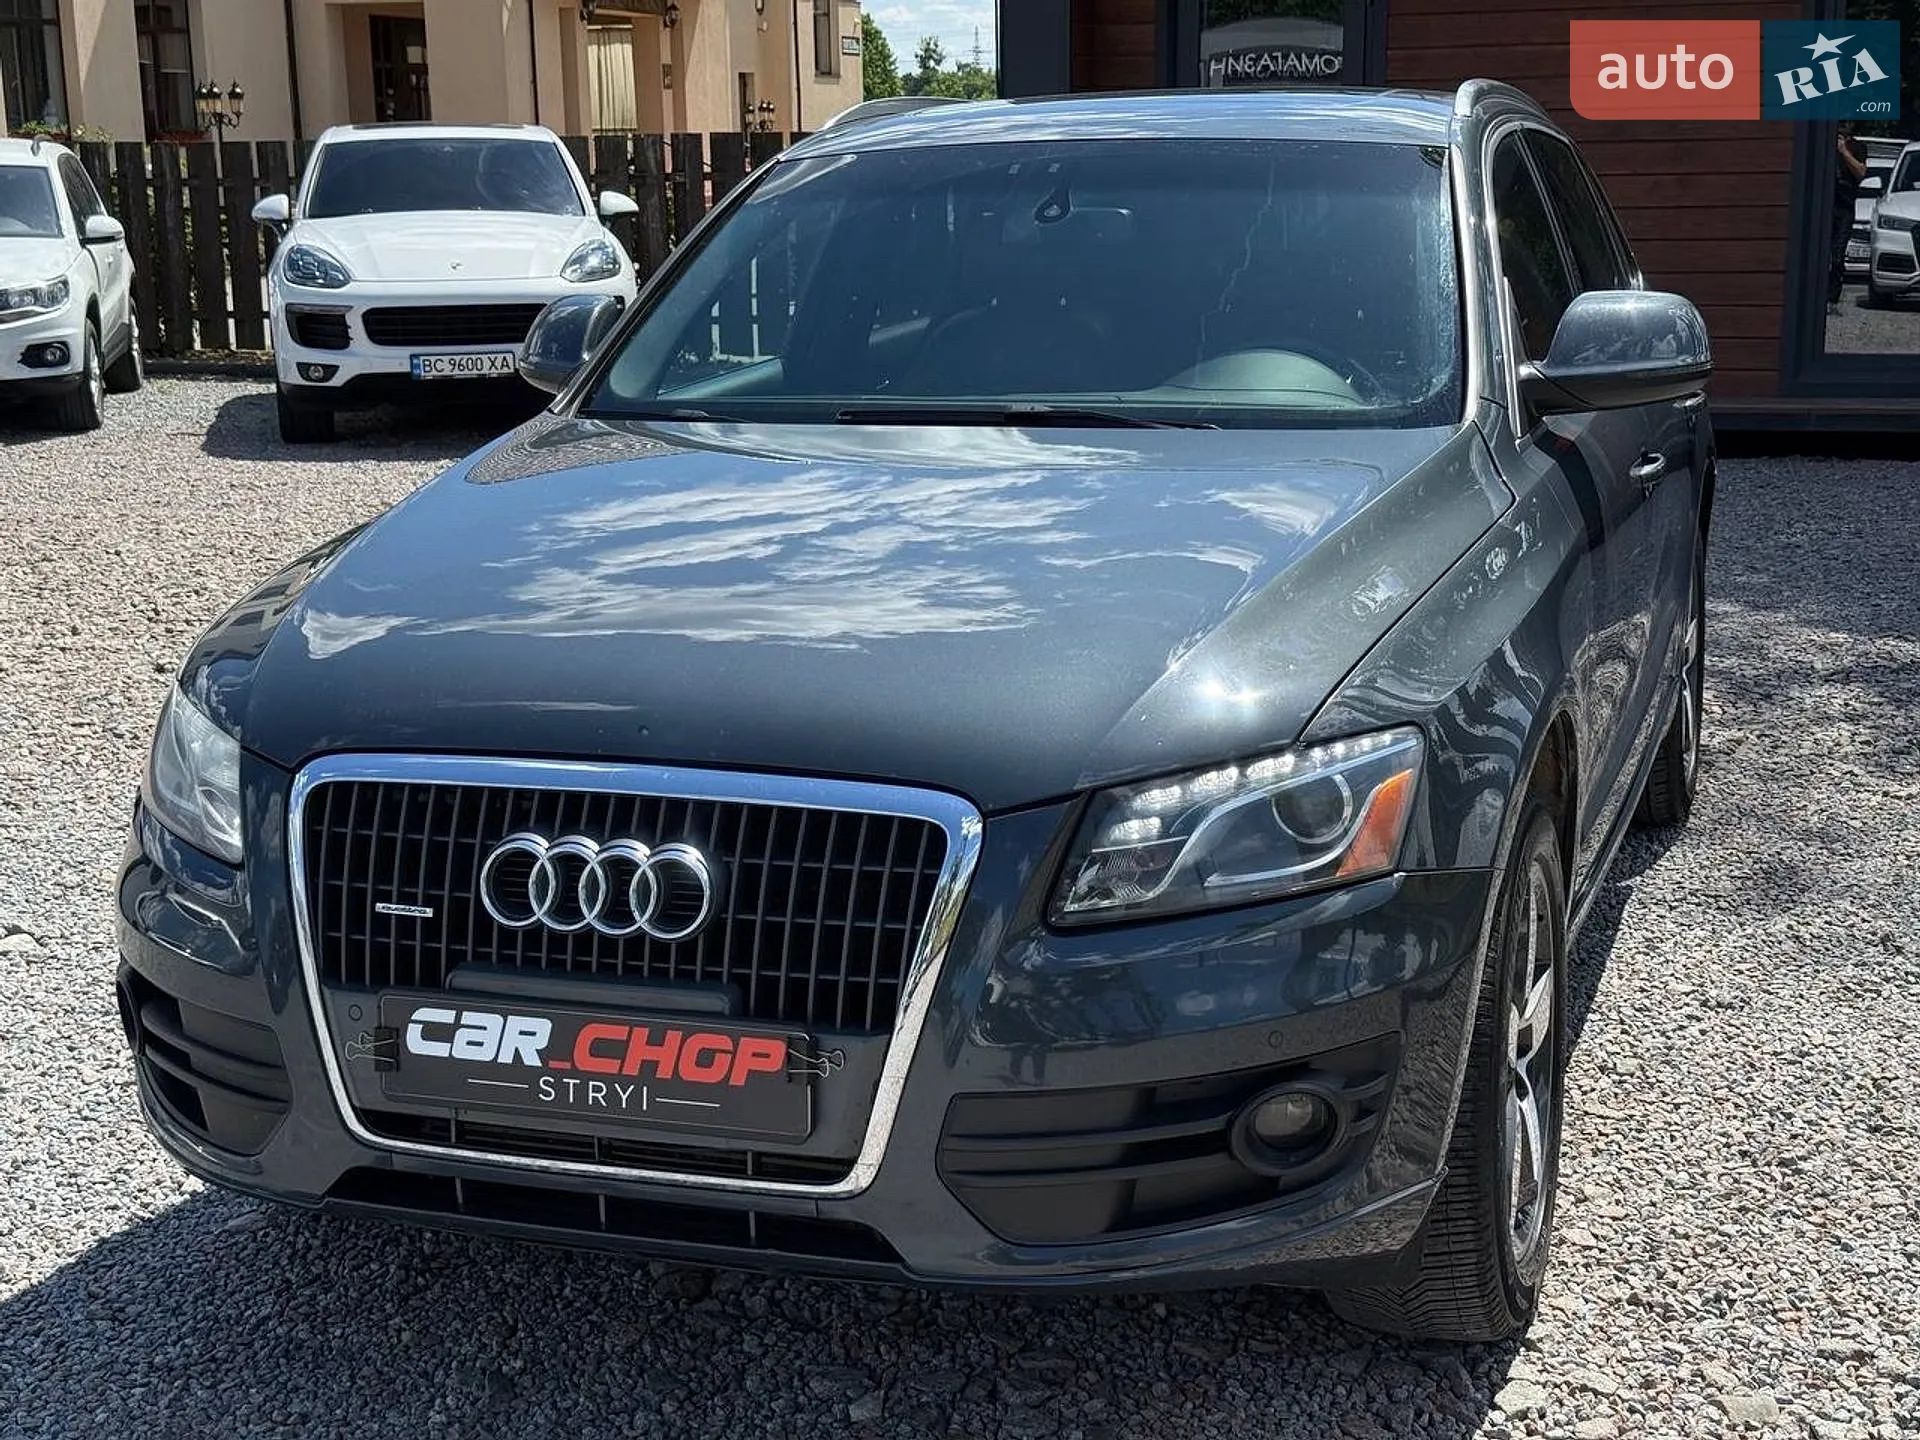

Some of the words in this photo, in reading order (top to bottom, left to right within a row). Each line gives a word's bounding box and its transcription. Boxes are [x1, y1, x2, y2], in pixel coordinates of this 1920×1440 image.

[422, 358, 445, 374] BC
[448, 357, 484, 373] 9600
[487, 355, 511, 371] XA
[537, 1076, 648, 1111] STRYI
